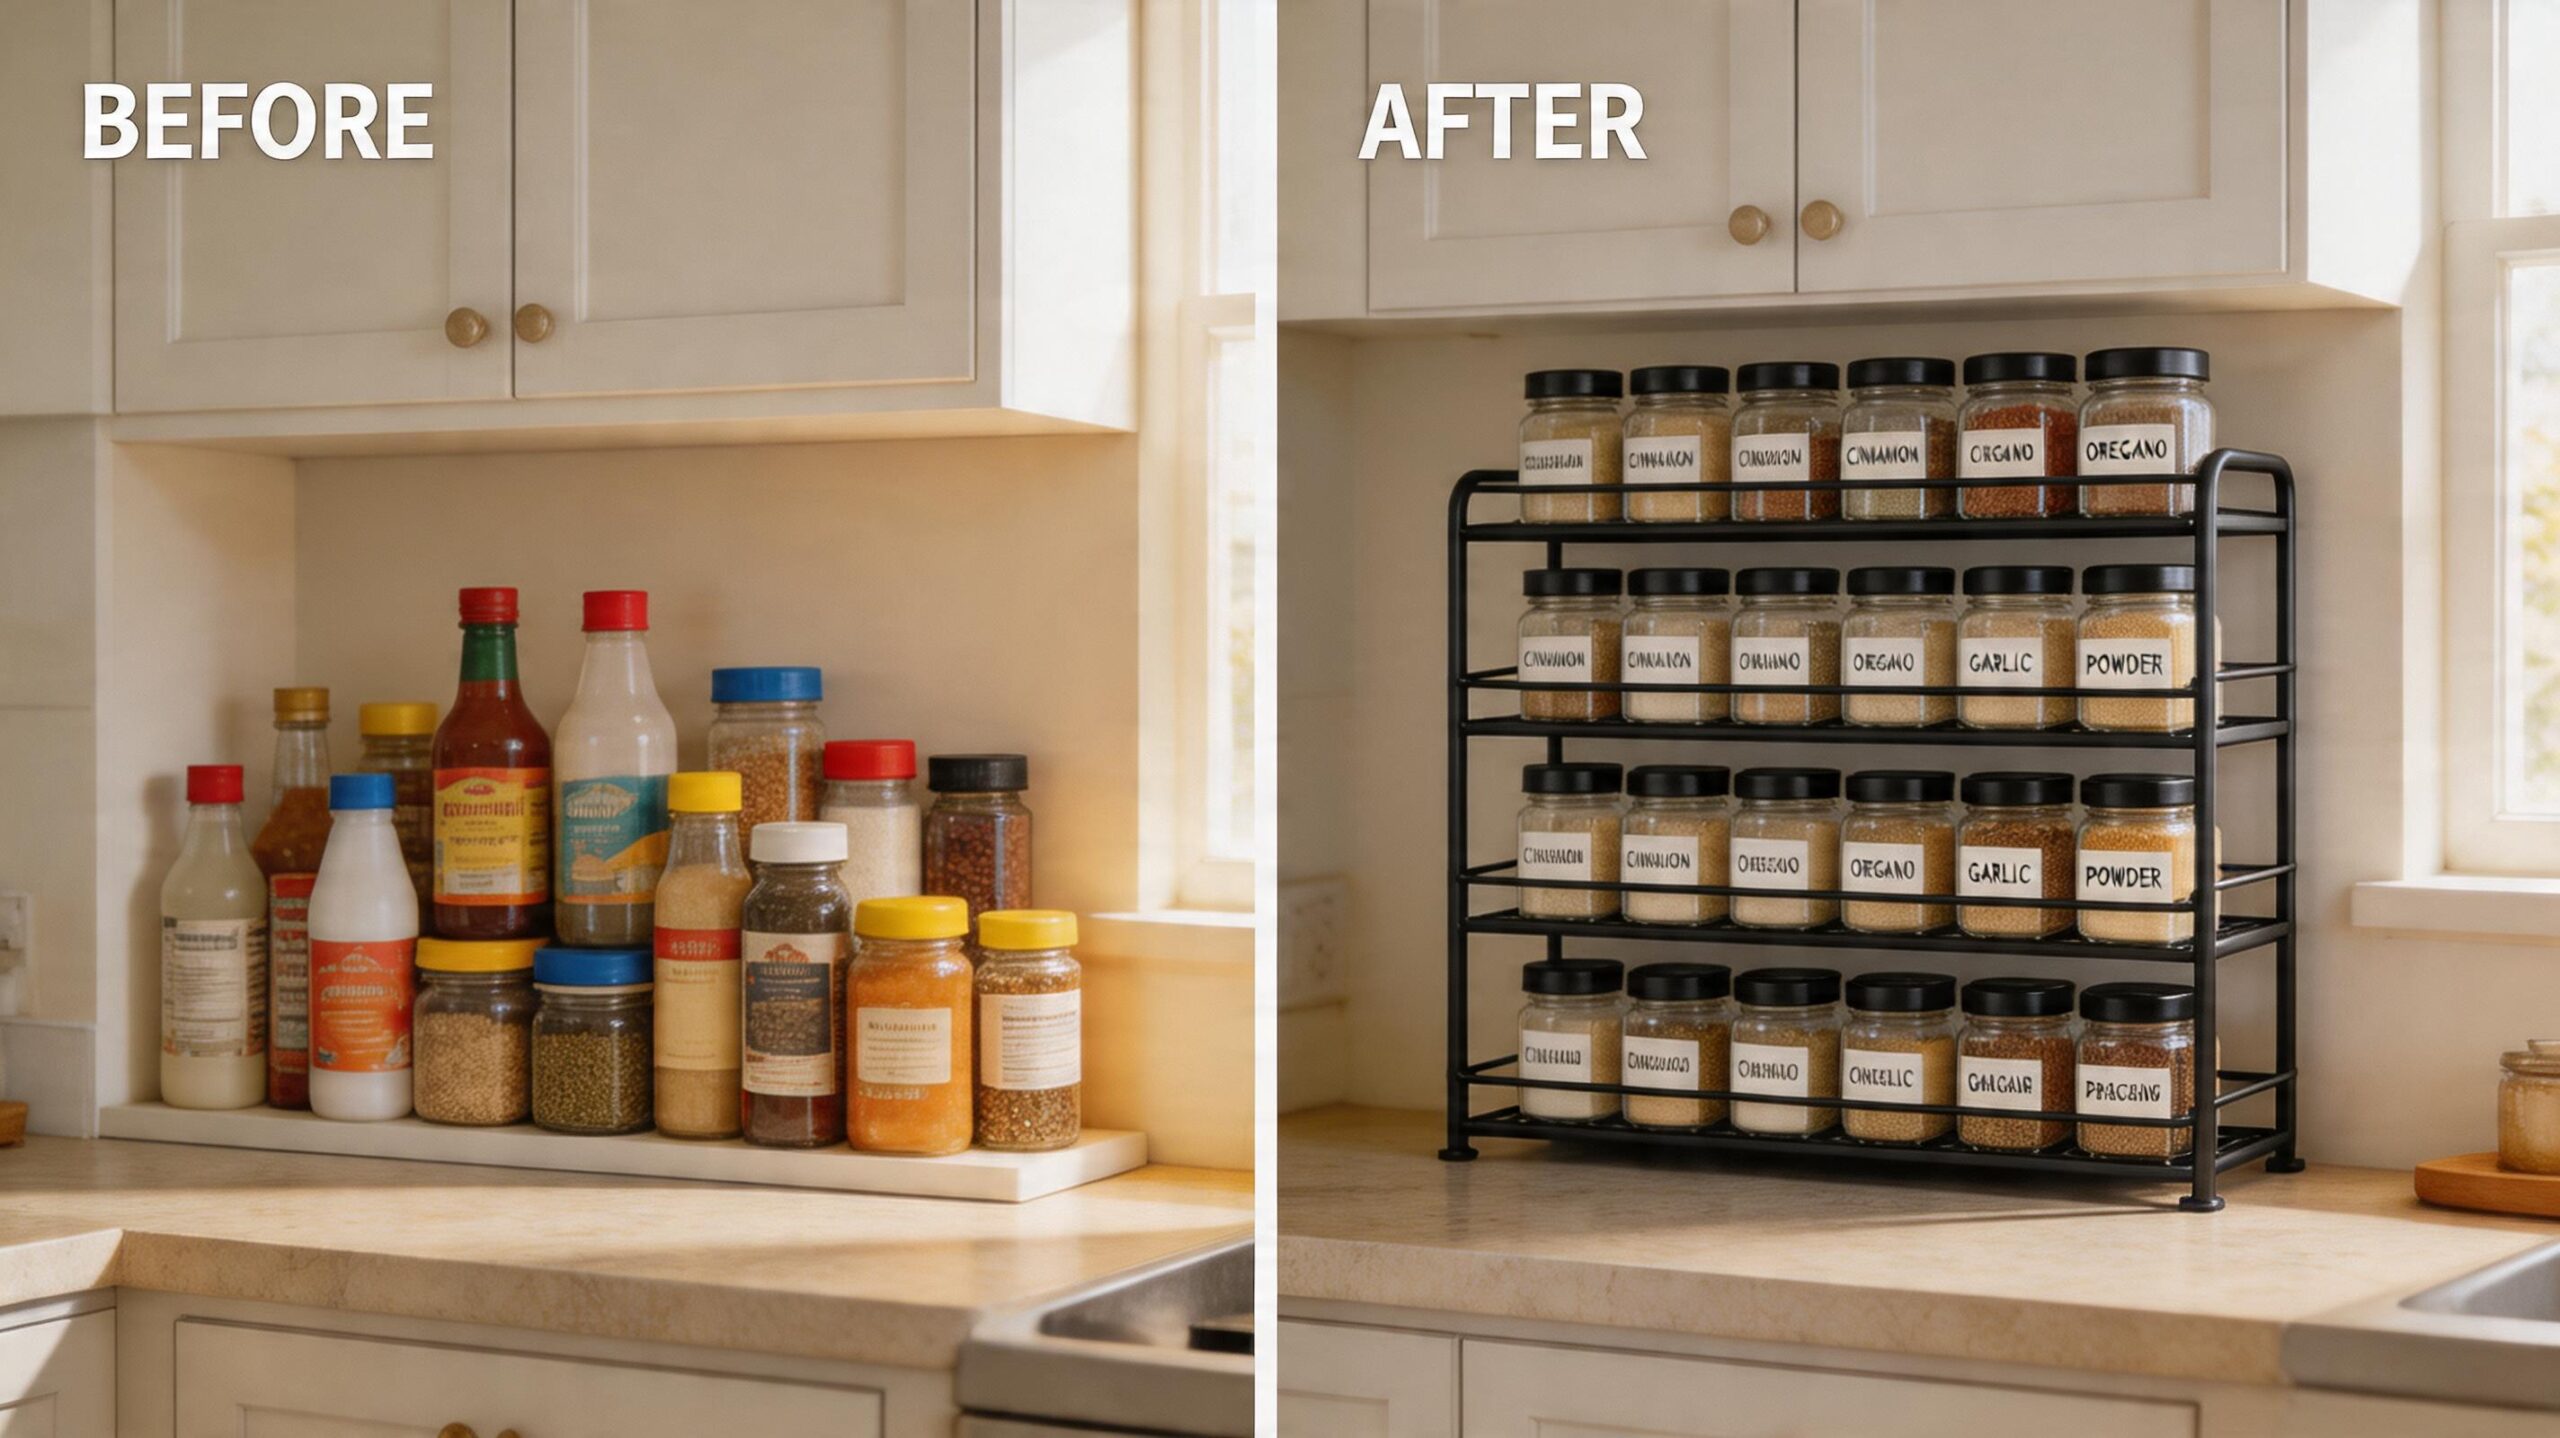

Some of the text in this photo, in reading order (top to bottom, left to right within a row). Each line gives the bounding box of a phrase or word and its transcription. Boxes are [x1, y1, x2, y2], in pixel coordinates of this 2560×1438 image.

[2086, 439, 2167, 461] OREGANO
[1969, 653, 2034, 673] GARLIC
[2086, 653, 2164, 676] POWDER
[1968, 862, 2032, 884] GARLIC
[2086, 865, 2163, 889] POWDER
